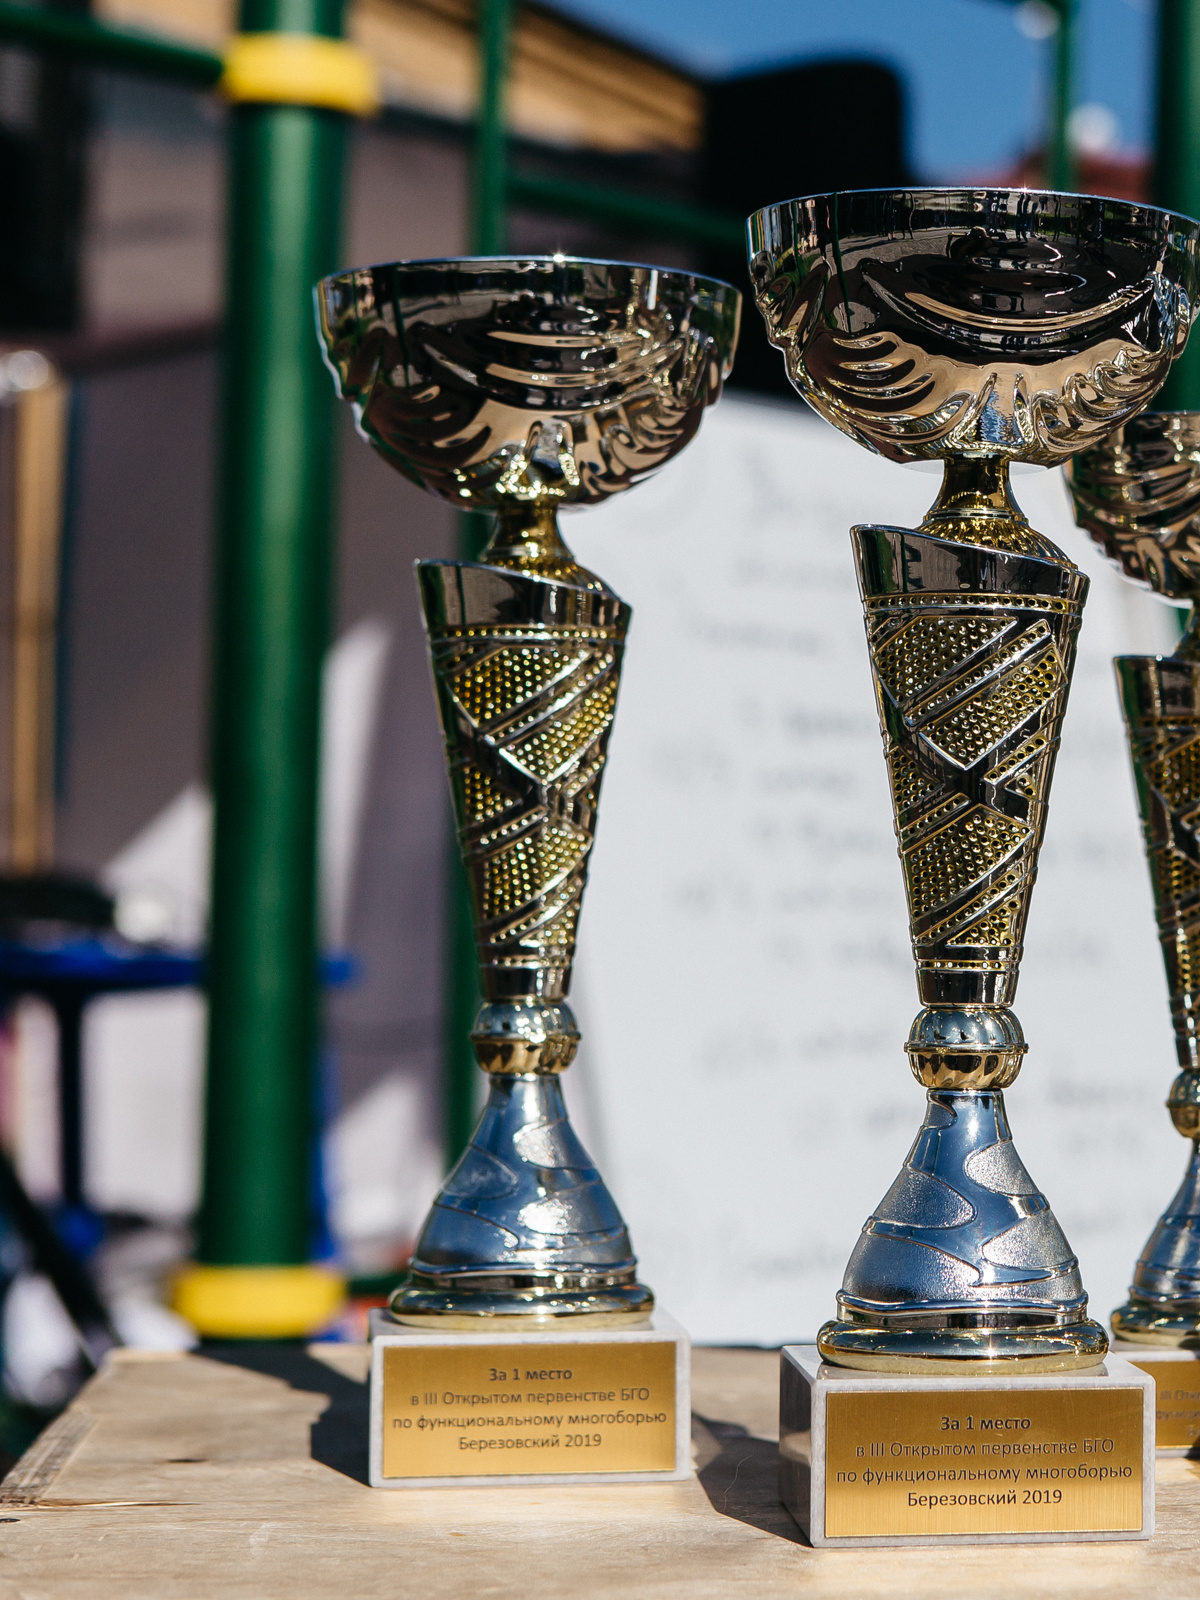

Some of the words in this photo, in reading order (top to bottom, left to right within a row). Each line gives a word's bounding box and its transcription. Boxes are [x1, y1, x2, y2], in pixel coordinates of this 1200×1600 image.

[489, 1368, 507, 1381] За
[513, 1369, 520, 1380] 1
[526, 1369, 572, 1380] место
[411, 1396, 419, 1405] в
[425, 1394, 437, 1405] III
[443, 1392, 522, 1407] Открытом
[527, 1390, 615, 1405] первенстве
[621, 1388, 649, 1401] БГО
[393, 1417, 412, 1429] по
[418, 1413, 563, 1430] функциональному
[568, 1411, 666, 1426] многоборью
[941, 1417, 960, 1430] За
[967, 1417, 974, 1429] 1
[980, 1417, 1031, 1429] место
[460, 1435, 560, 1452] Березовский
[565, 1435, 602, 1448] 2019
[857, 1446, 864, 1458] в
[871, 1443, 884, 1457] III
[890, 1442, 976, 1459] Открытом
[982, 1441, 1077, 1458] первенстве
[1083, 1439, 1114, 1453] БГО
[837, 1470, 857, 1482] по
[862, 1467, 1020, 1484] функциональному
[1026, 1465, 1132, 1481] многоборью
[908, 1490, 1017, 1509] Березовский
[1023, 1490, 1062, 1504] 2019
